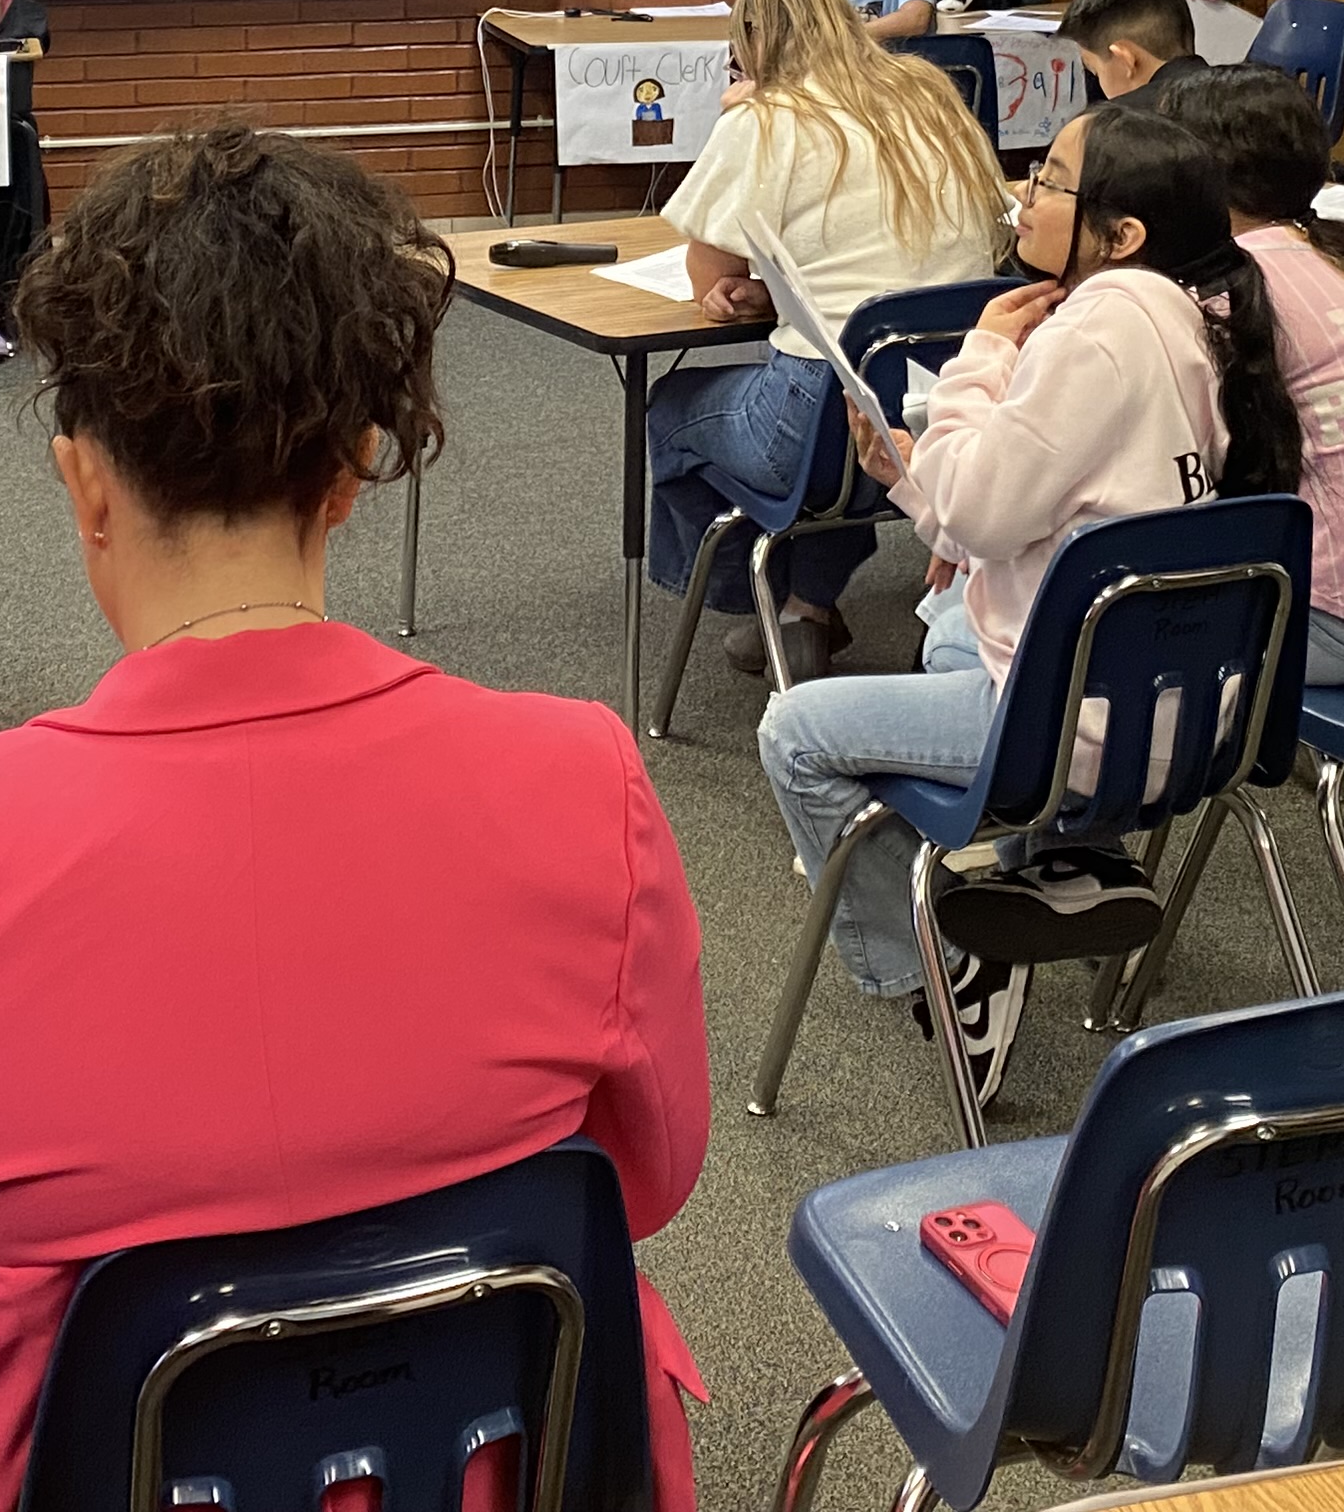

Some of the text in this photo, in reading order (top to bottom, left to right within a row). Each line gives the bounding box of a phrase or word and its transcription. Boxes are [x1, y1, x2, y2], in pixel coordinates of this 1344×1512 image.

[568, 46, 716, 88] Court Clerk
[1172, 451, 1216, 505] B
[1154, 618, 1208, 641] Room
[309, 1362, 416, 1401] Room
